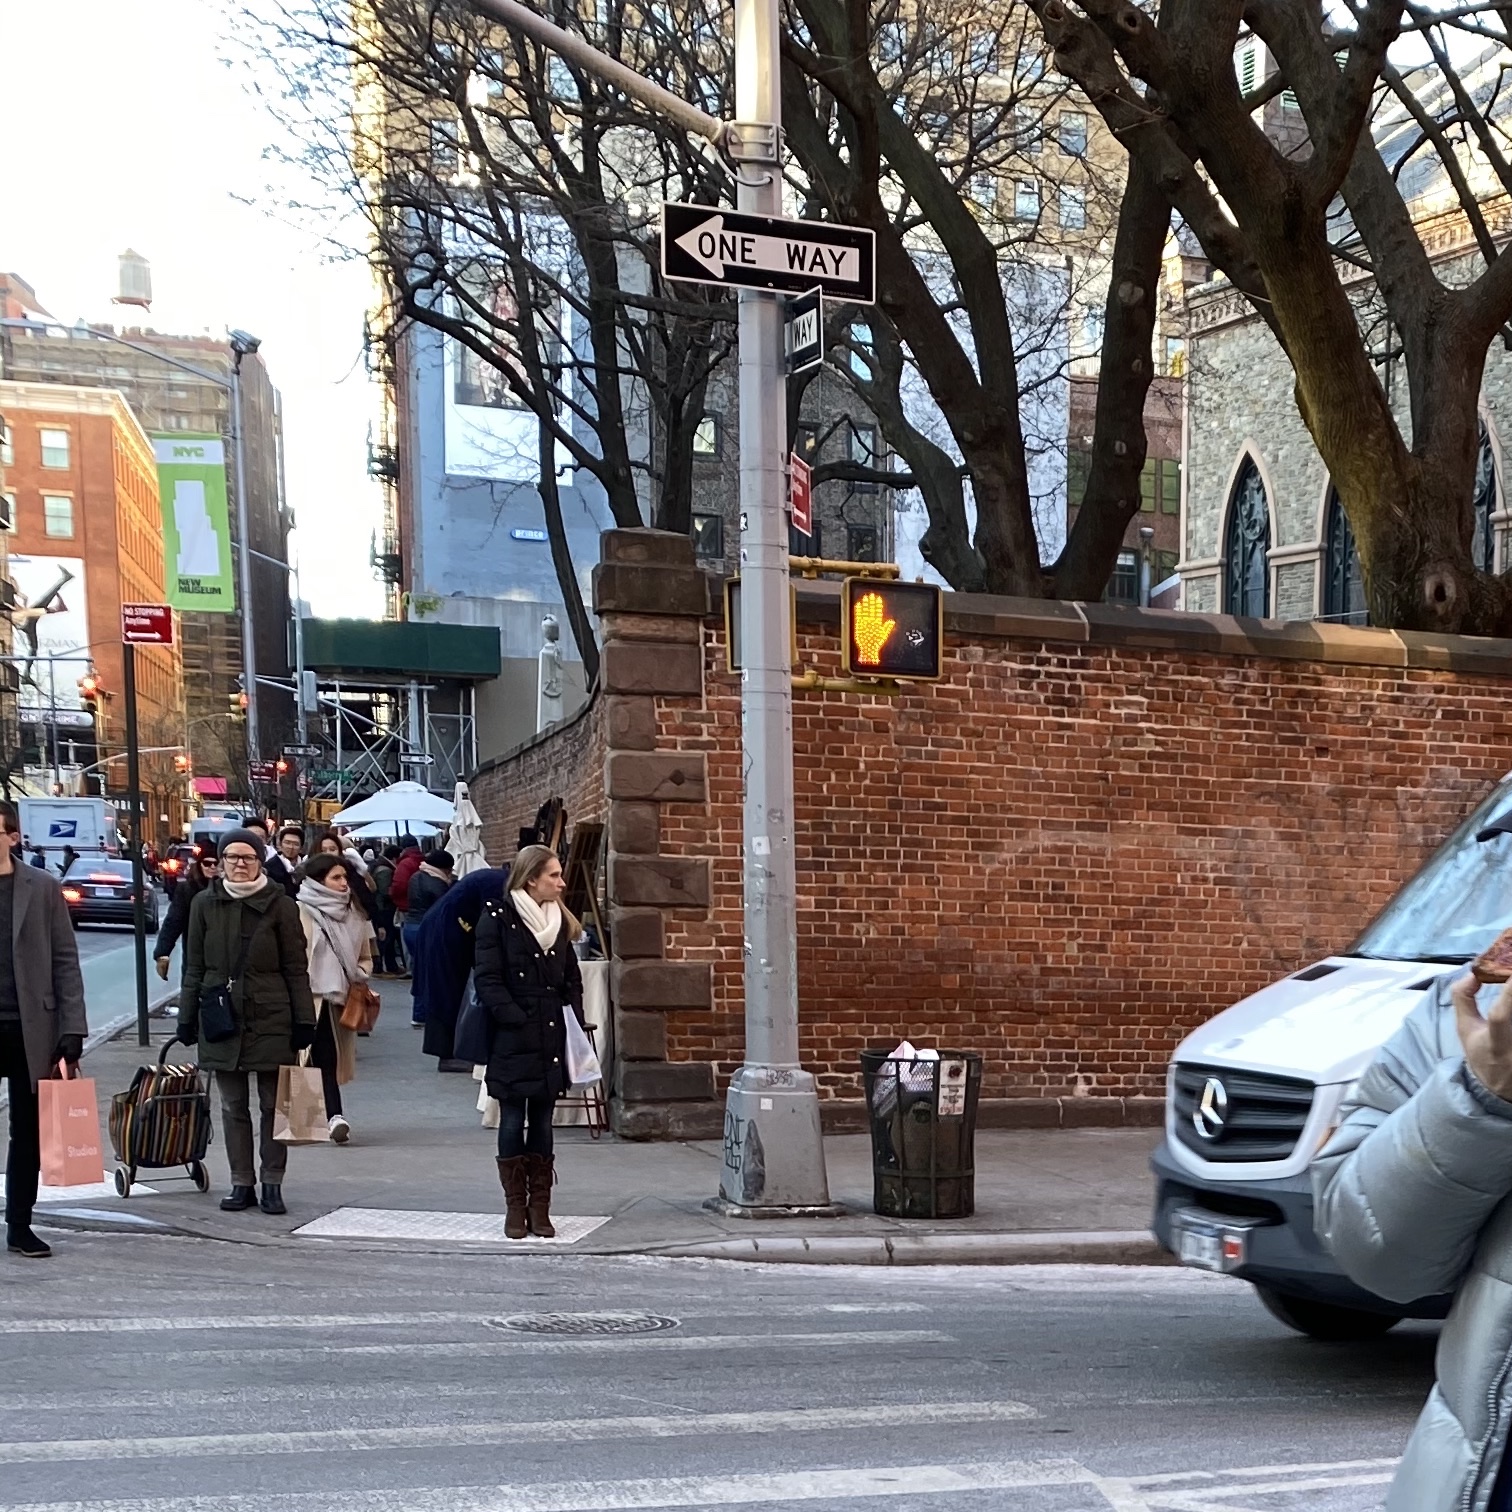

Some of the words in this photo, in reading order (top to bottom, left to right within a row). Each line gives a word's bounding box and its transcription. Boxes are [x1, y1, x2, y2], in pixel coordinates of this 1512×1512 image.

[698, 231, 756, 264] ONE
[786, 243, 846, 276] WAY
[793, 314, 813, 352] WAY
[173, 446, 204, 457] NYC
[178, 579, 201, 587] NEW
[178, 586, 221, 595] MUSEUM
[124, 607, 133, 615] NO
[134, 607, 164, 616] STOPPING
[125, 617, 150, 626] Anytime
[68, 1105, 89, 1118] Acne
[67, 1144, 98, 1158] Studios
